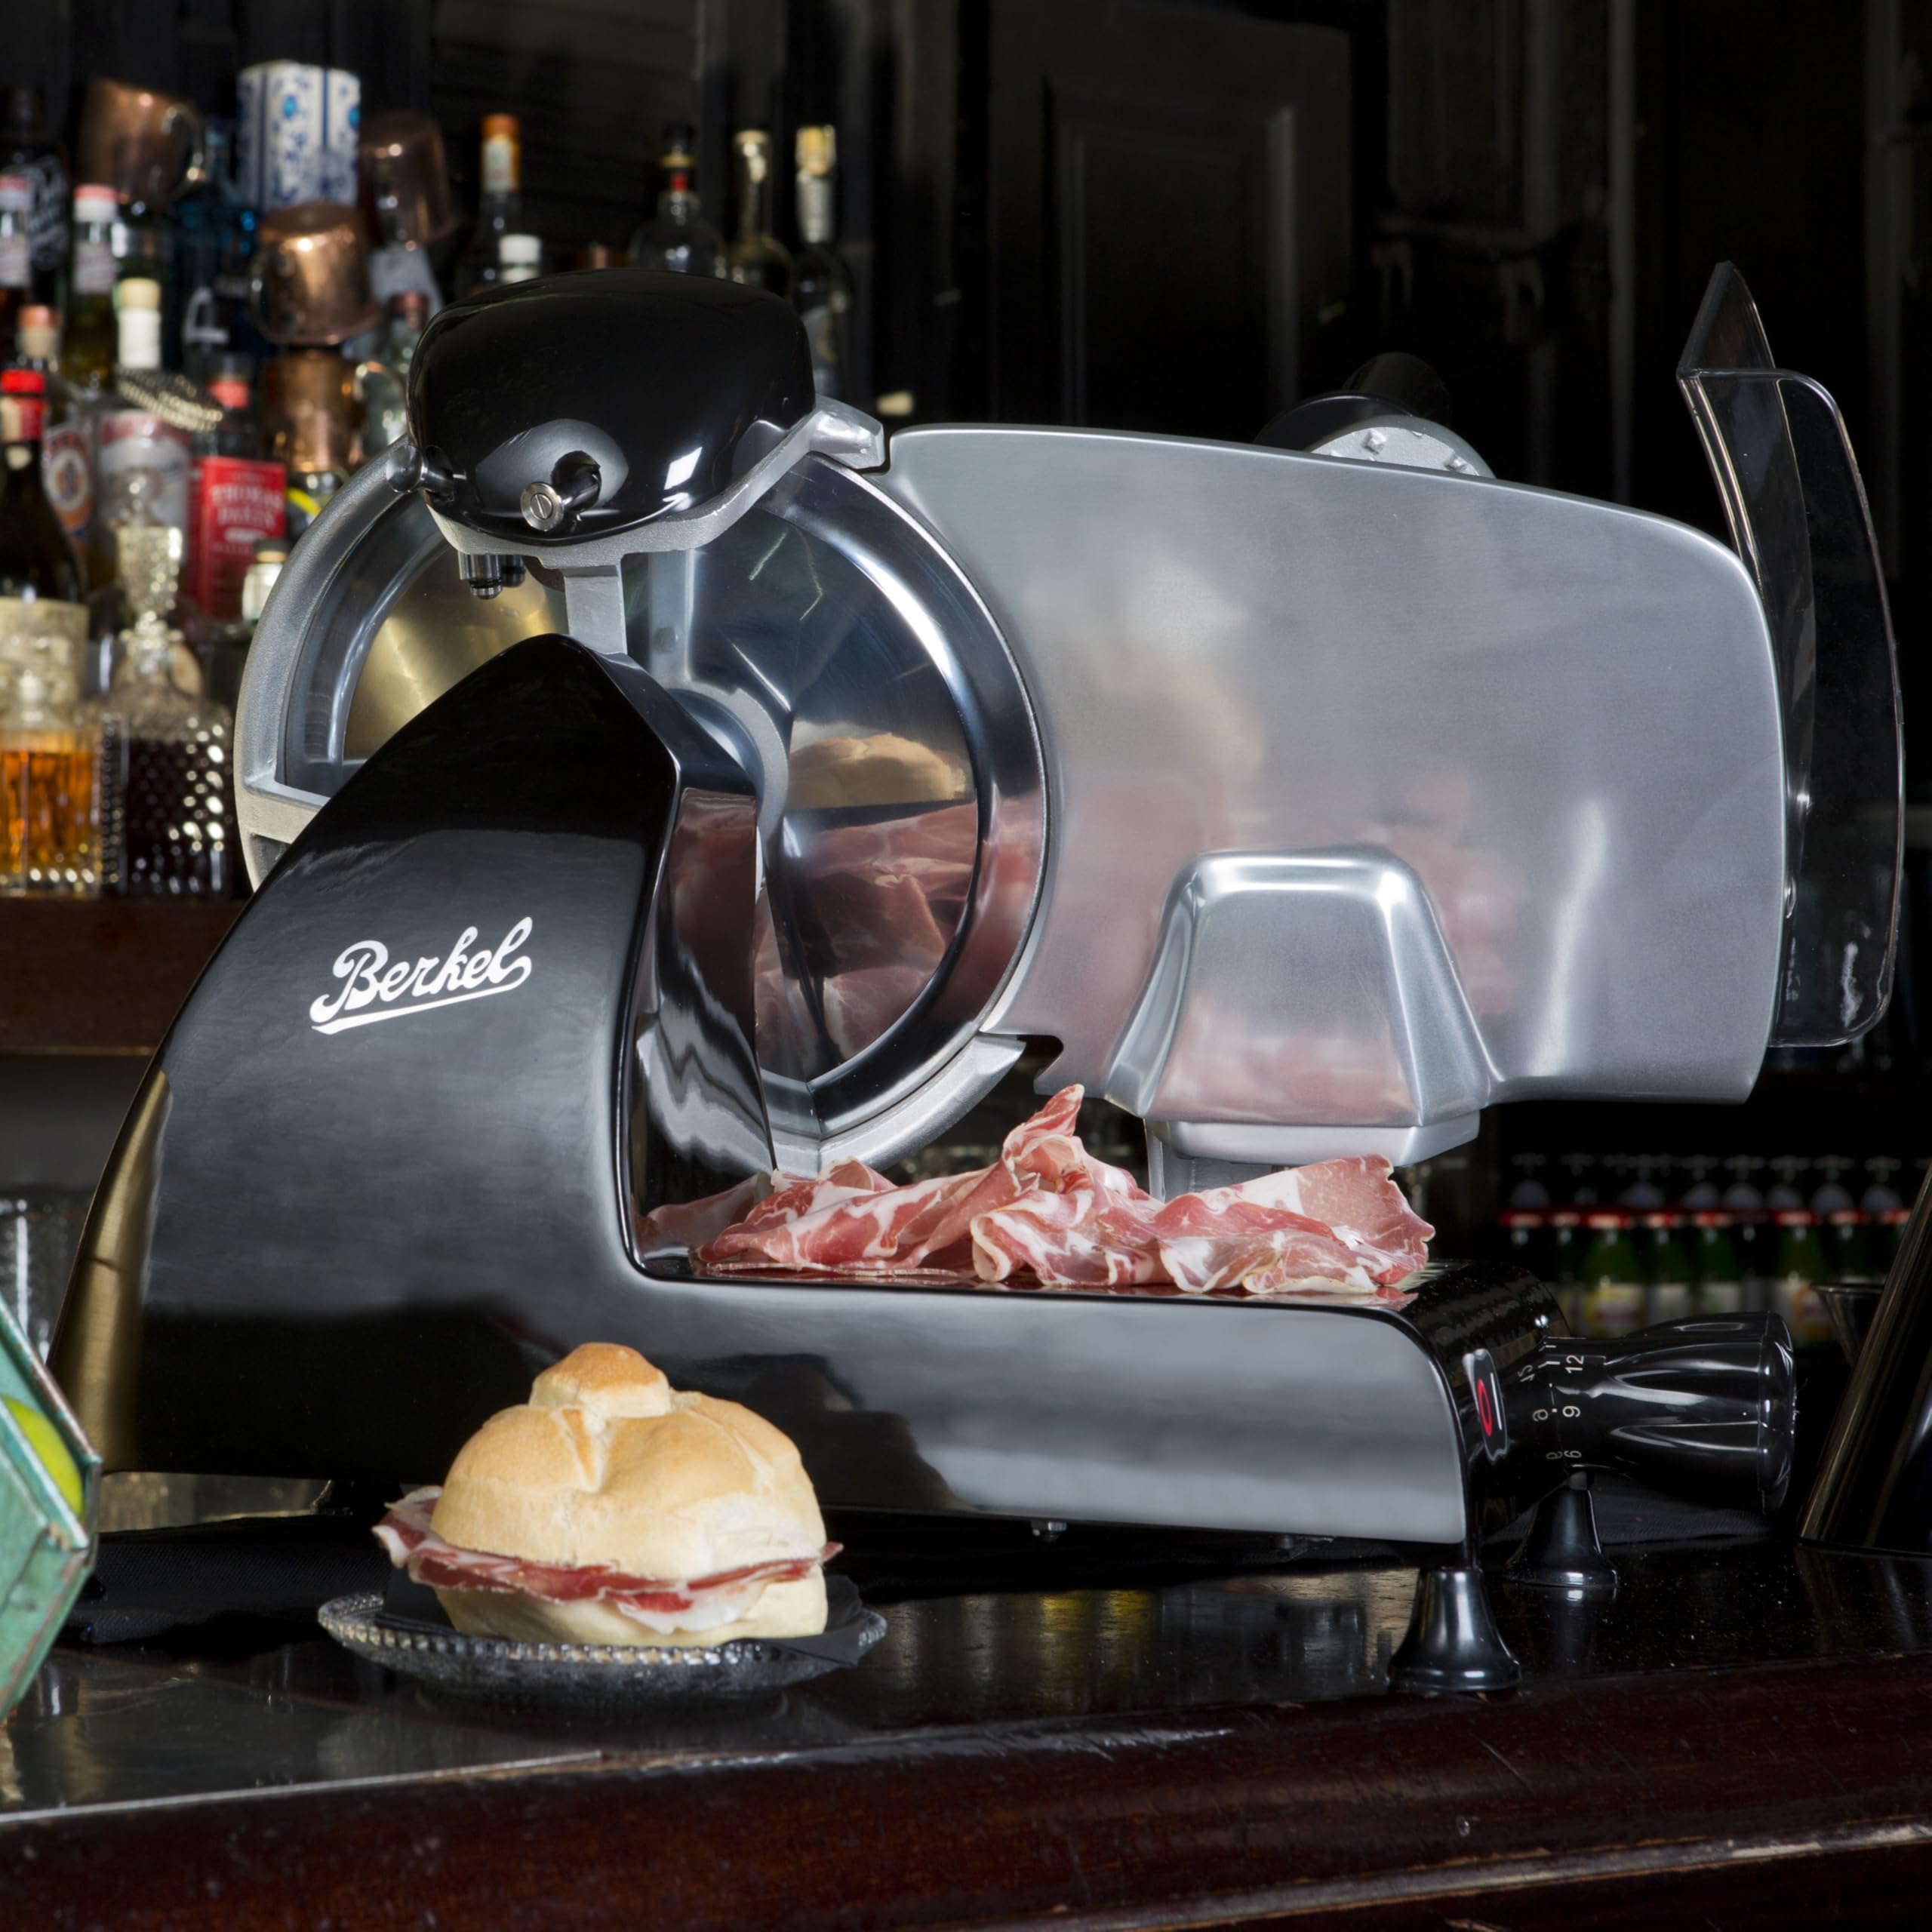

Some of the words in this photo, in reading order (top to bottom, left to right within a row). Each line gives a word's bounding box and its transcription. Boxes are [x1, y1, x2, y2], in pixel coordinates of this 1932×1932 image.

[309, 916, 533, 1035] Berkel
[1564, 1355, 1585, 1374] 12
[1561, 1405, 1581, 1418] 9
